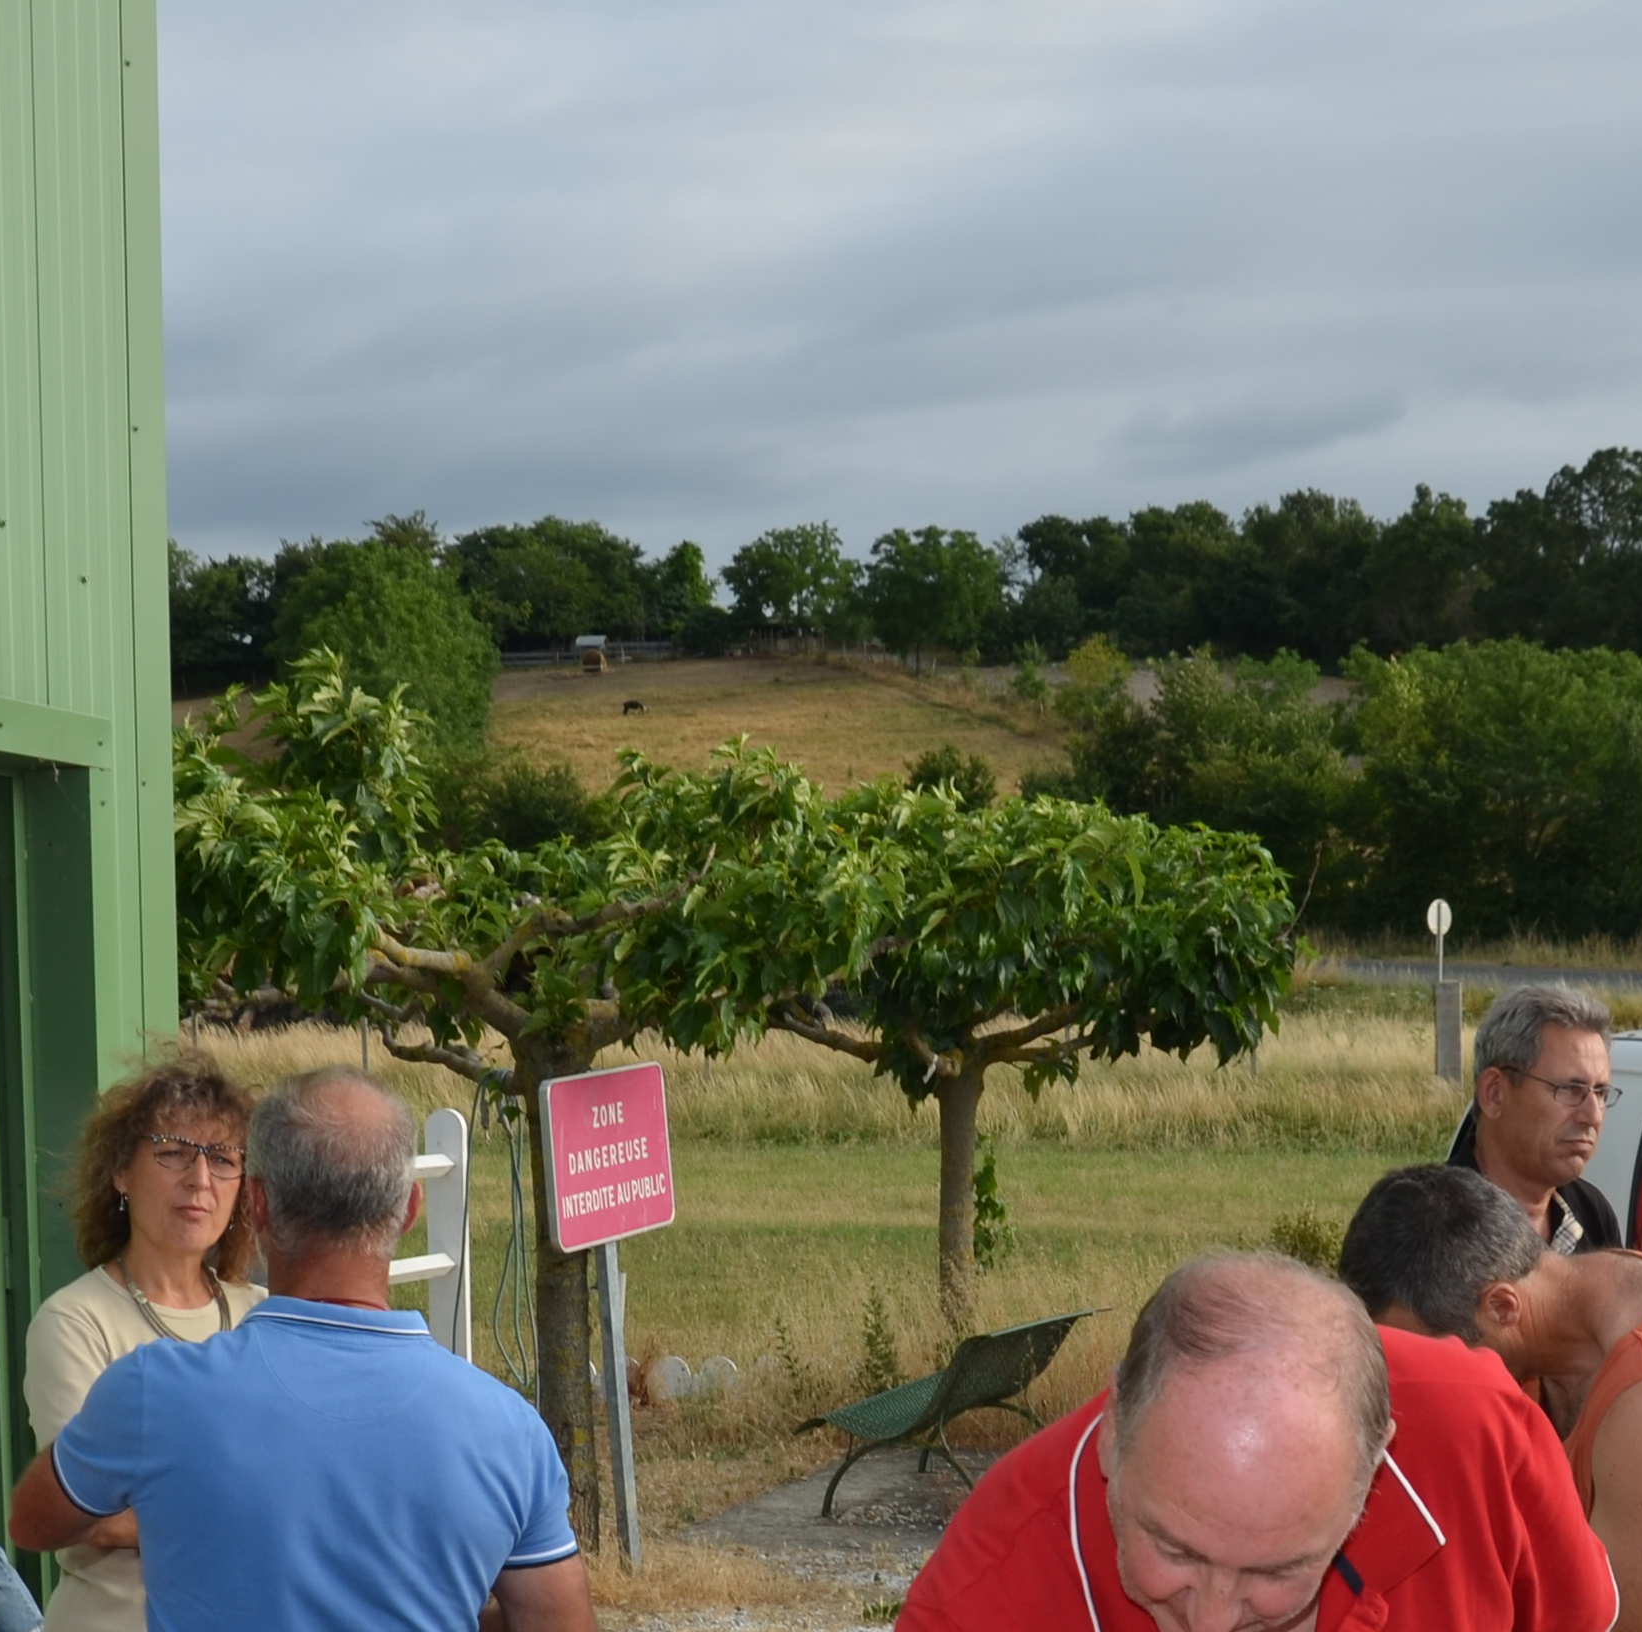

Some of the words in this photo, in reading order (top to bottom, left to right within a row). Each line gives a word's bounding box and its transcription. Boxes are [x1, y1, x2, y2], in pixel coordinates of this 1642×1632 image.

[592, 1101, 624, 1129] ZONE
[568, 1136, 649, 1176] DANGEREUSE
[562, 1185, 616, 1219] INTERDITE
[617, 1181, 631, 1205] AU
[632, 1172, 666, 1202] PUBLIC
